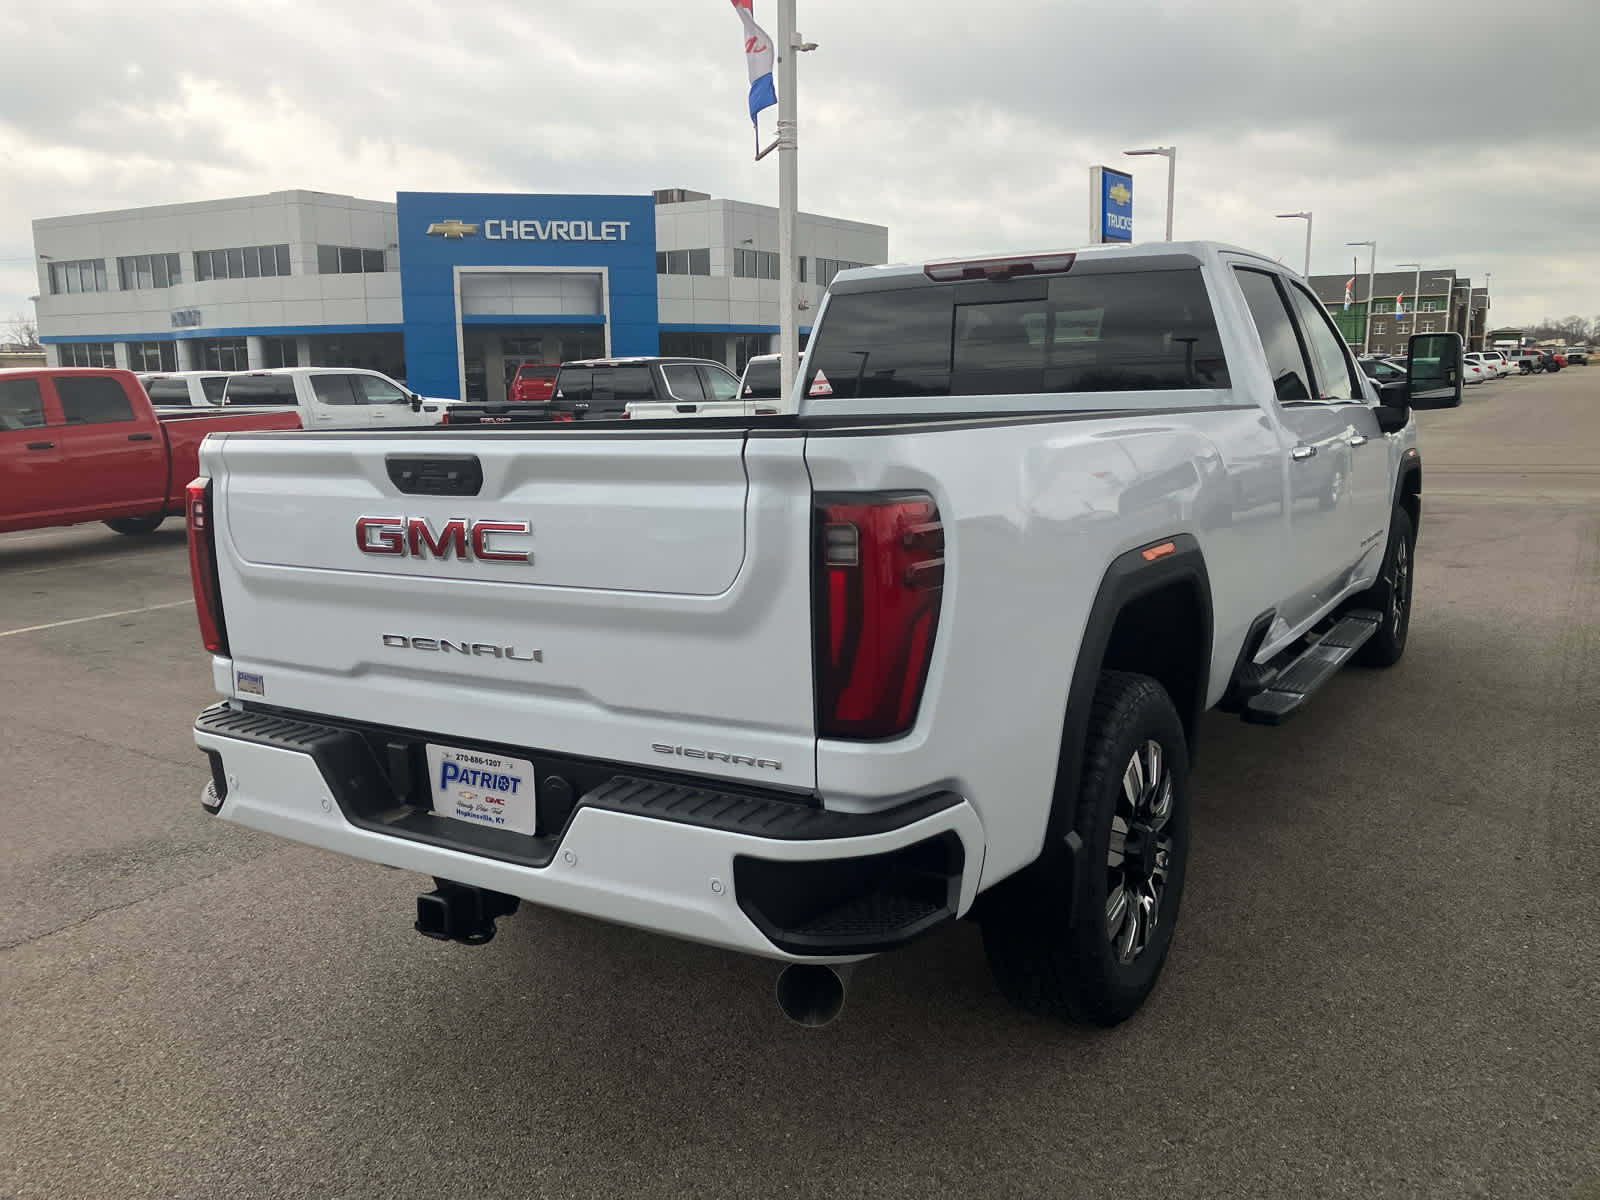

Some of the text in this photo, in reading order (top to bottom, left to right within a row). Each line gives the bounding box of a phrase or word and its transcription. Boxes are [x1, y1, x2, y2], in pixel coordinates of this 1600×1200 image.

[484, 219, 631, 241] CHEVROLET
[1106, 212, 1133, 231] TRUCKS
[355, 515, 534, 566] GMC
[382, 633, 543, 663] DENALI
[651, 743, 782, 770] SIERRA
[440, 761, 521, 793] PATRIOT
[495, 815, 505, 825] KY
